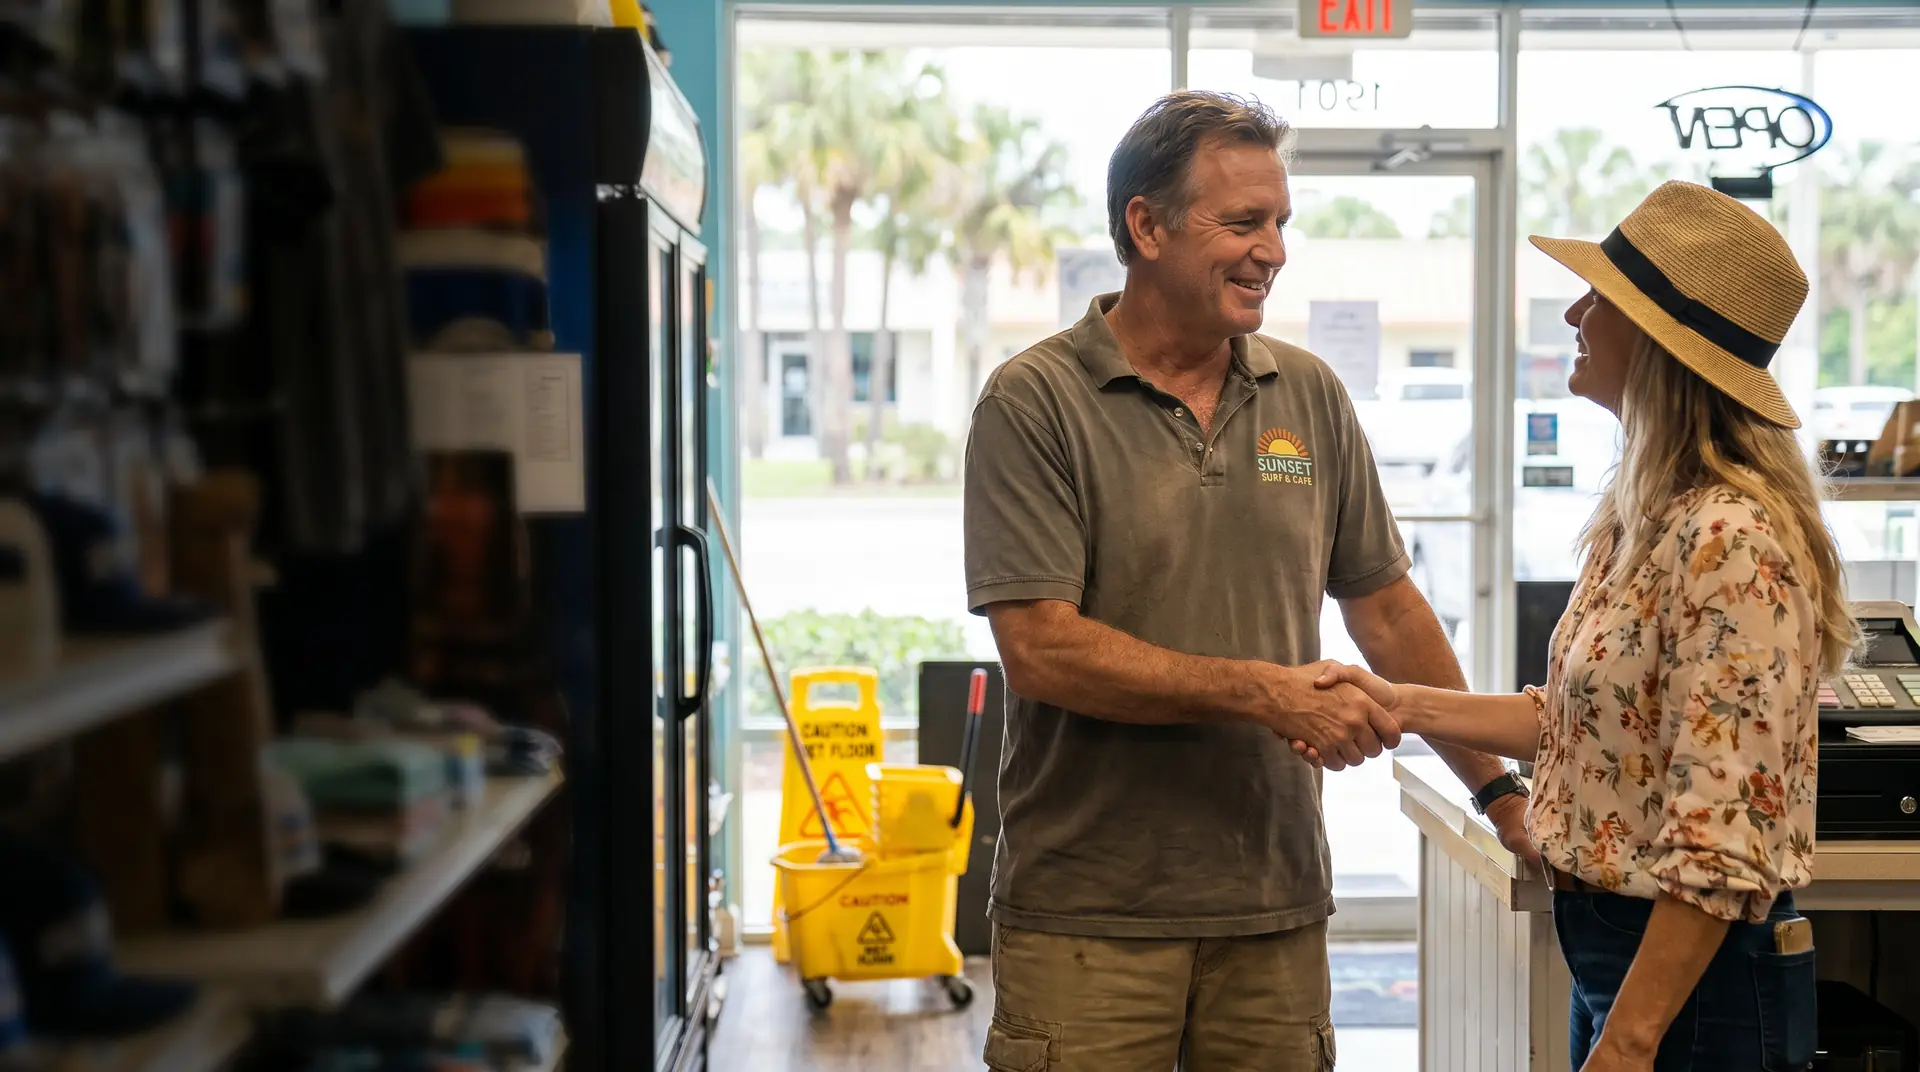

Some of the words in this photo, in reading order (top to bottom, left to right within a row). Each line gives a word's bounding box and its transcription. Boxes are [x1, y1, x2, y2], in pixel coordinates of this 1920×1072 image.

[1257, 457, 1312, 477] SUNSET
[1262, 472, 1283, 482] SURF
[1284, 474, 1291, 483] &
[1292, 475, 1312, 486] CAFE
[802, 722, 868, 738] CAUTION
[839, 893, 909, 908] CAUTION
